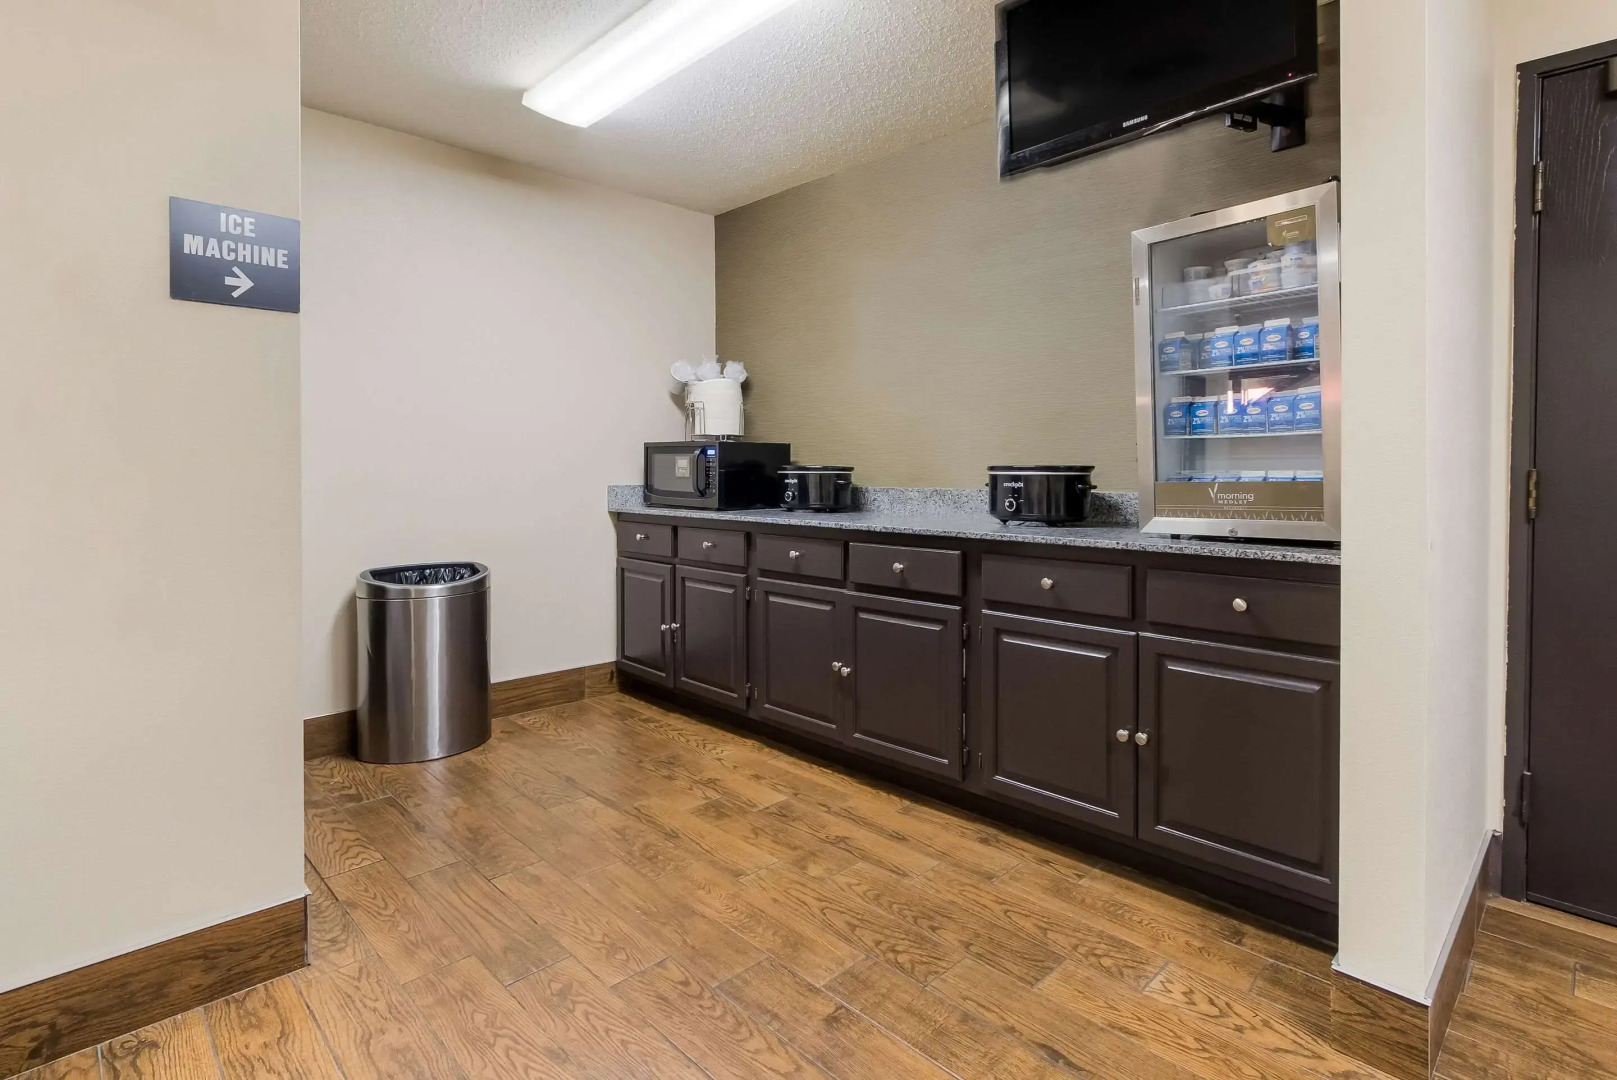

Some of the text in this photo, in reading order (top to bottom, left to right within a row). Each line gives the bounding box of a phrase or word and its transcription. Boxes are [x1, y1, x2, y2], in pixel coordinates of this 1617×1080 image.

[1122, 114, 1148, 128] SAMSUNG
[219, 212, 256, 238] ICE
[183, 233, 289, 269] MACHINE
[1217, 491, 1254, 502] morning
